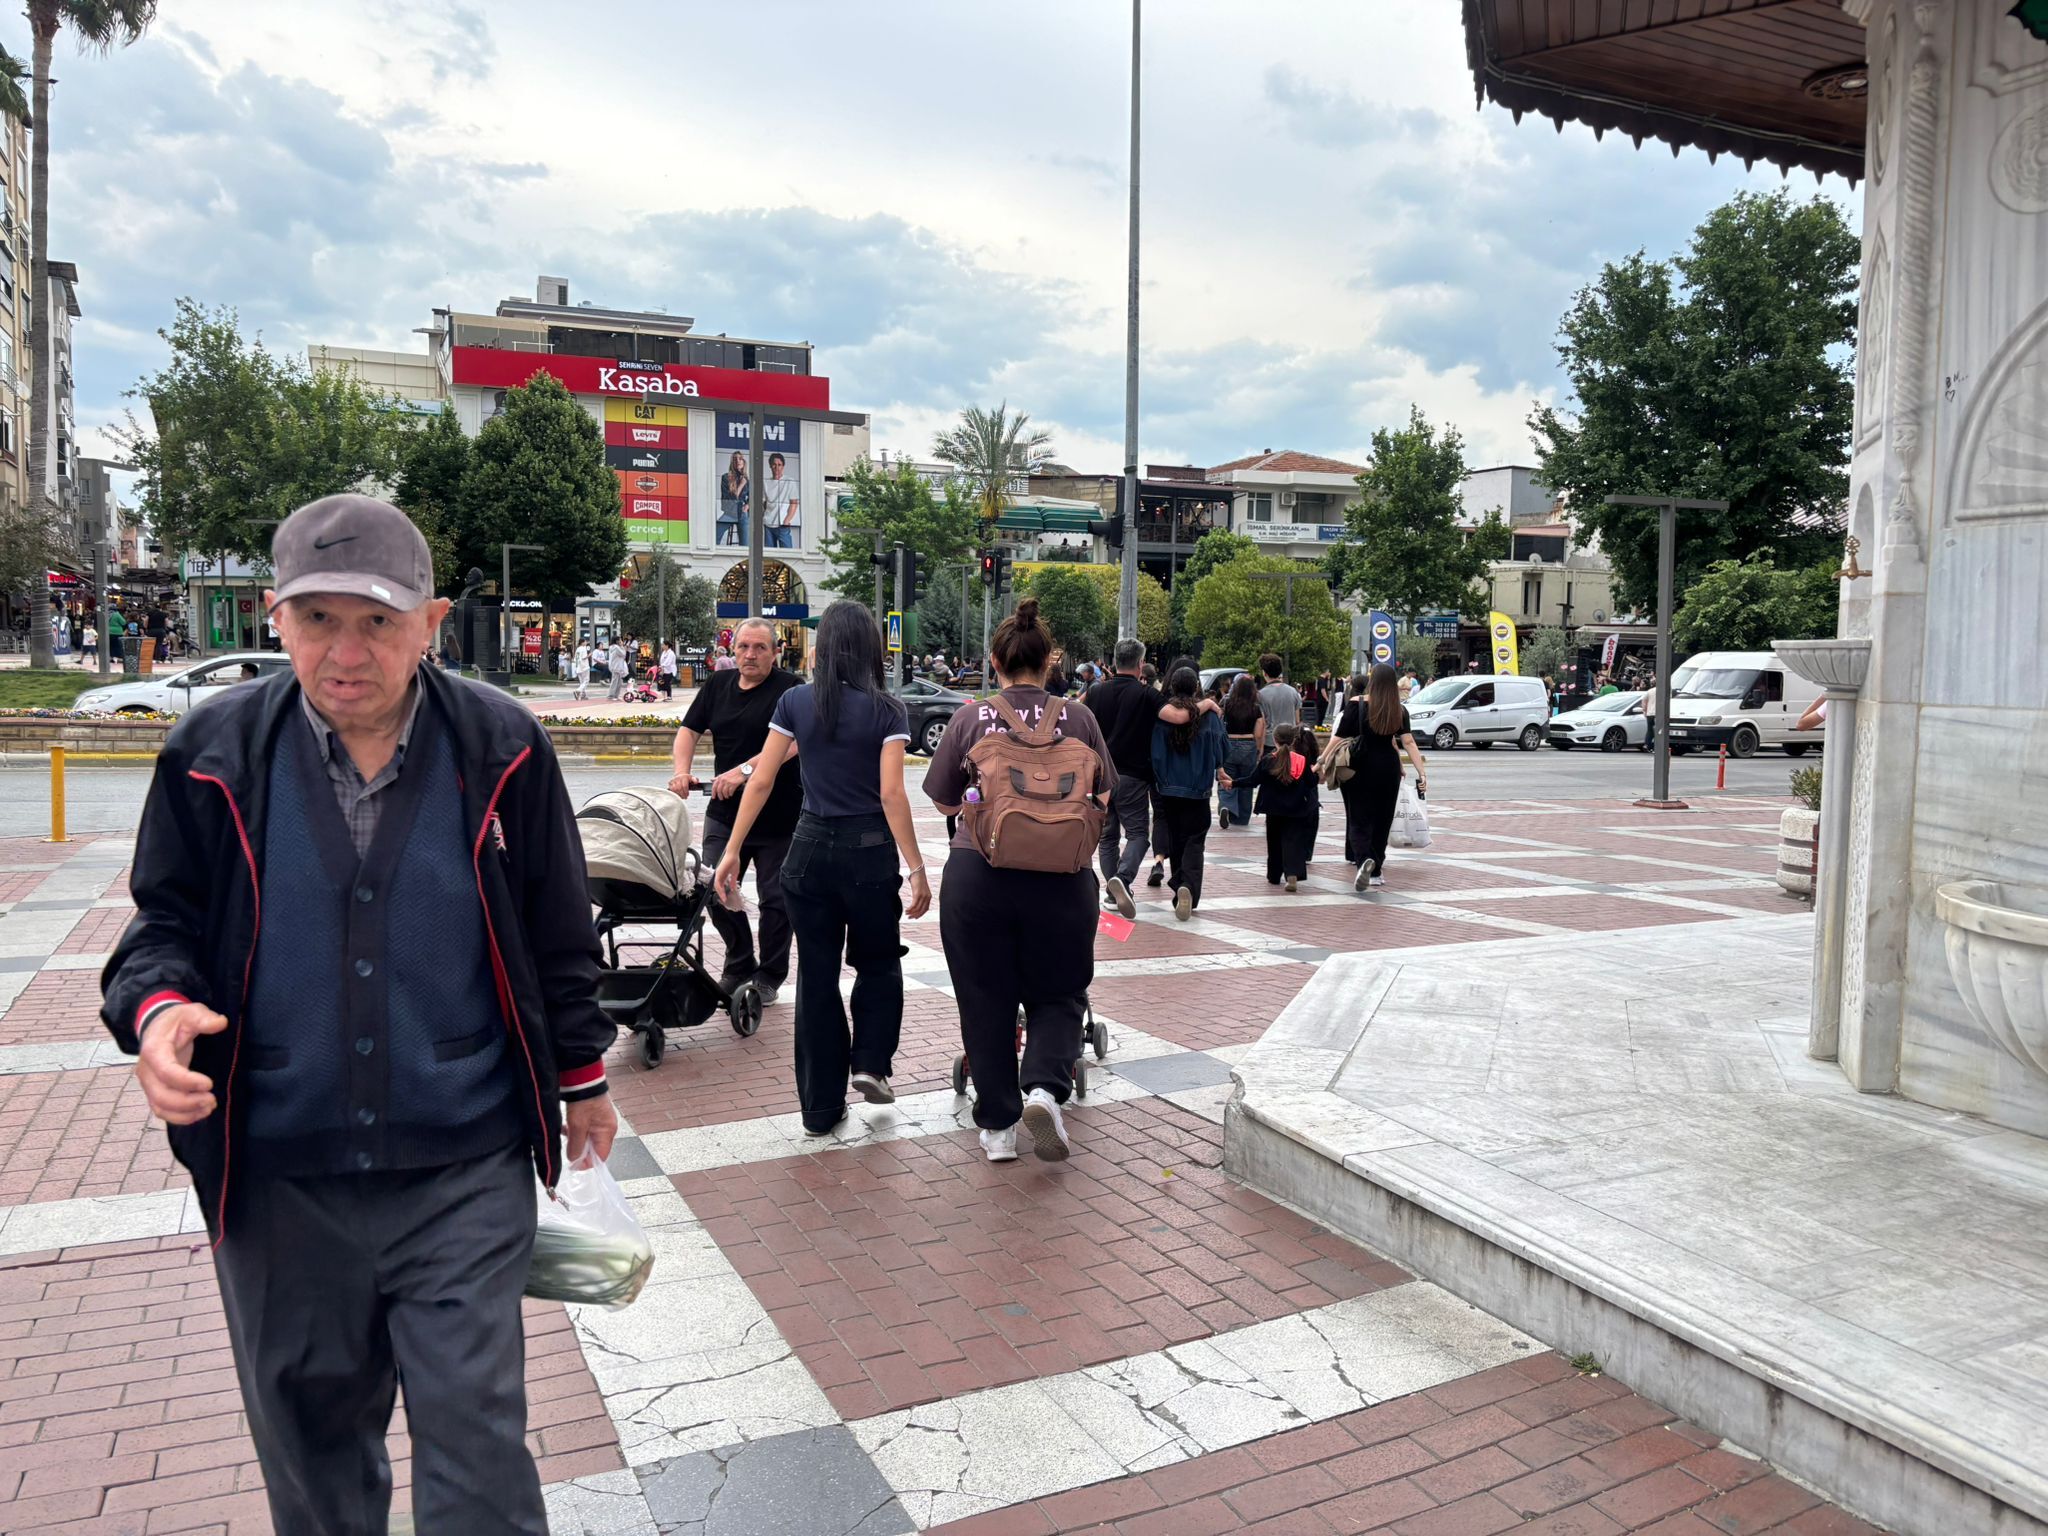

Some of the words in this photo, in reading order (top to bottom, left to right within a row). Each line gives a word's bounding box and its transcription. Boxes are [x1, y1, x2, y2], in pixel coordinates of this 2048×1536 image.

[643, 364, 663, 372] SEVEN
[598, 367, 700, 397] Kasaba
[634, 405, 656, 419] CAT
[728, 421, 785, 441] mvi
[632, 458, 656, 467] PUMA
[635, 501, 660, 511] CAMPER
[629, 525, 664, 534] crocs
[191, 560, 211, 573] TEB
[1034, 704, 1068, 720] bd
